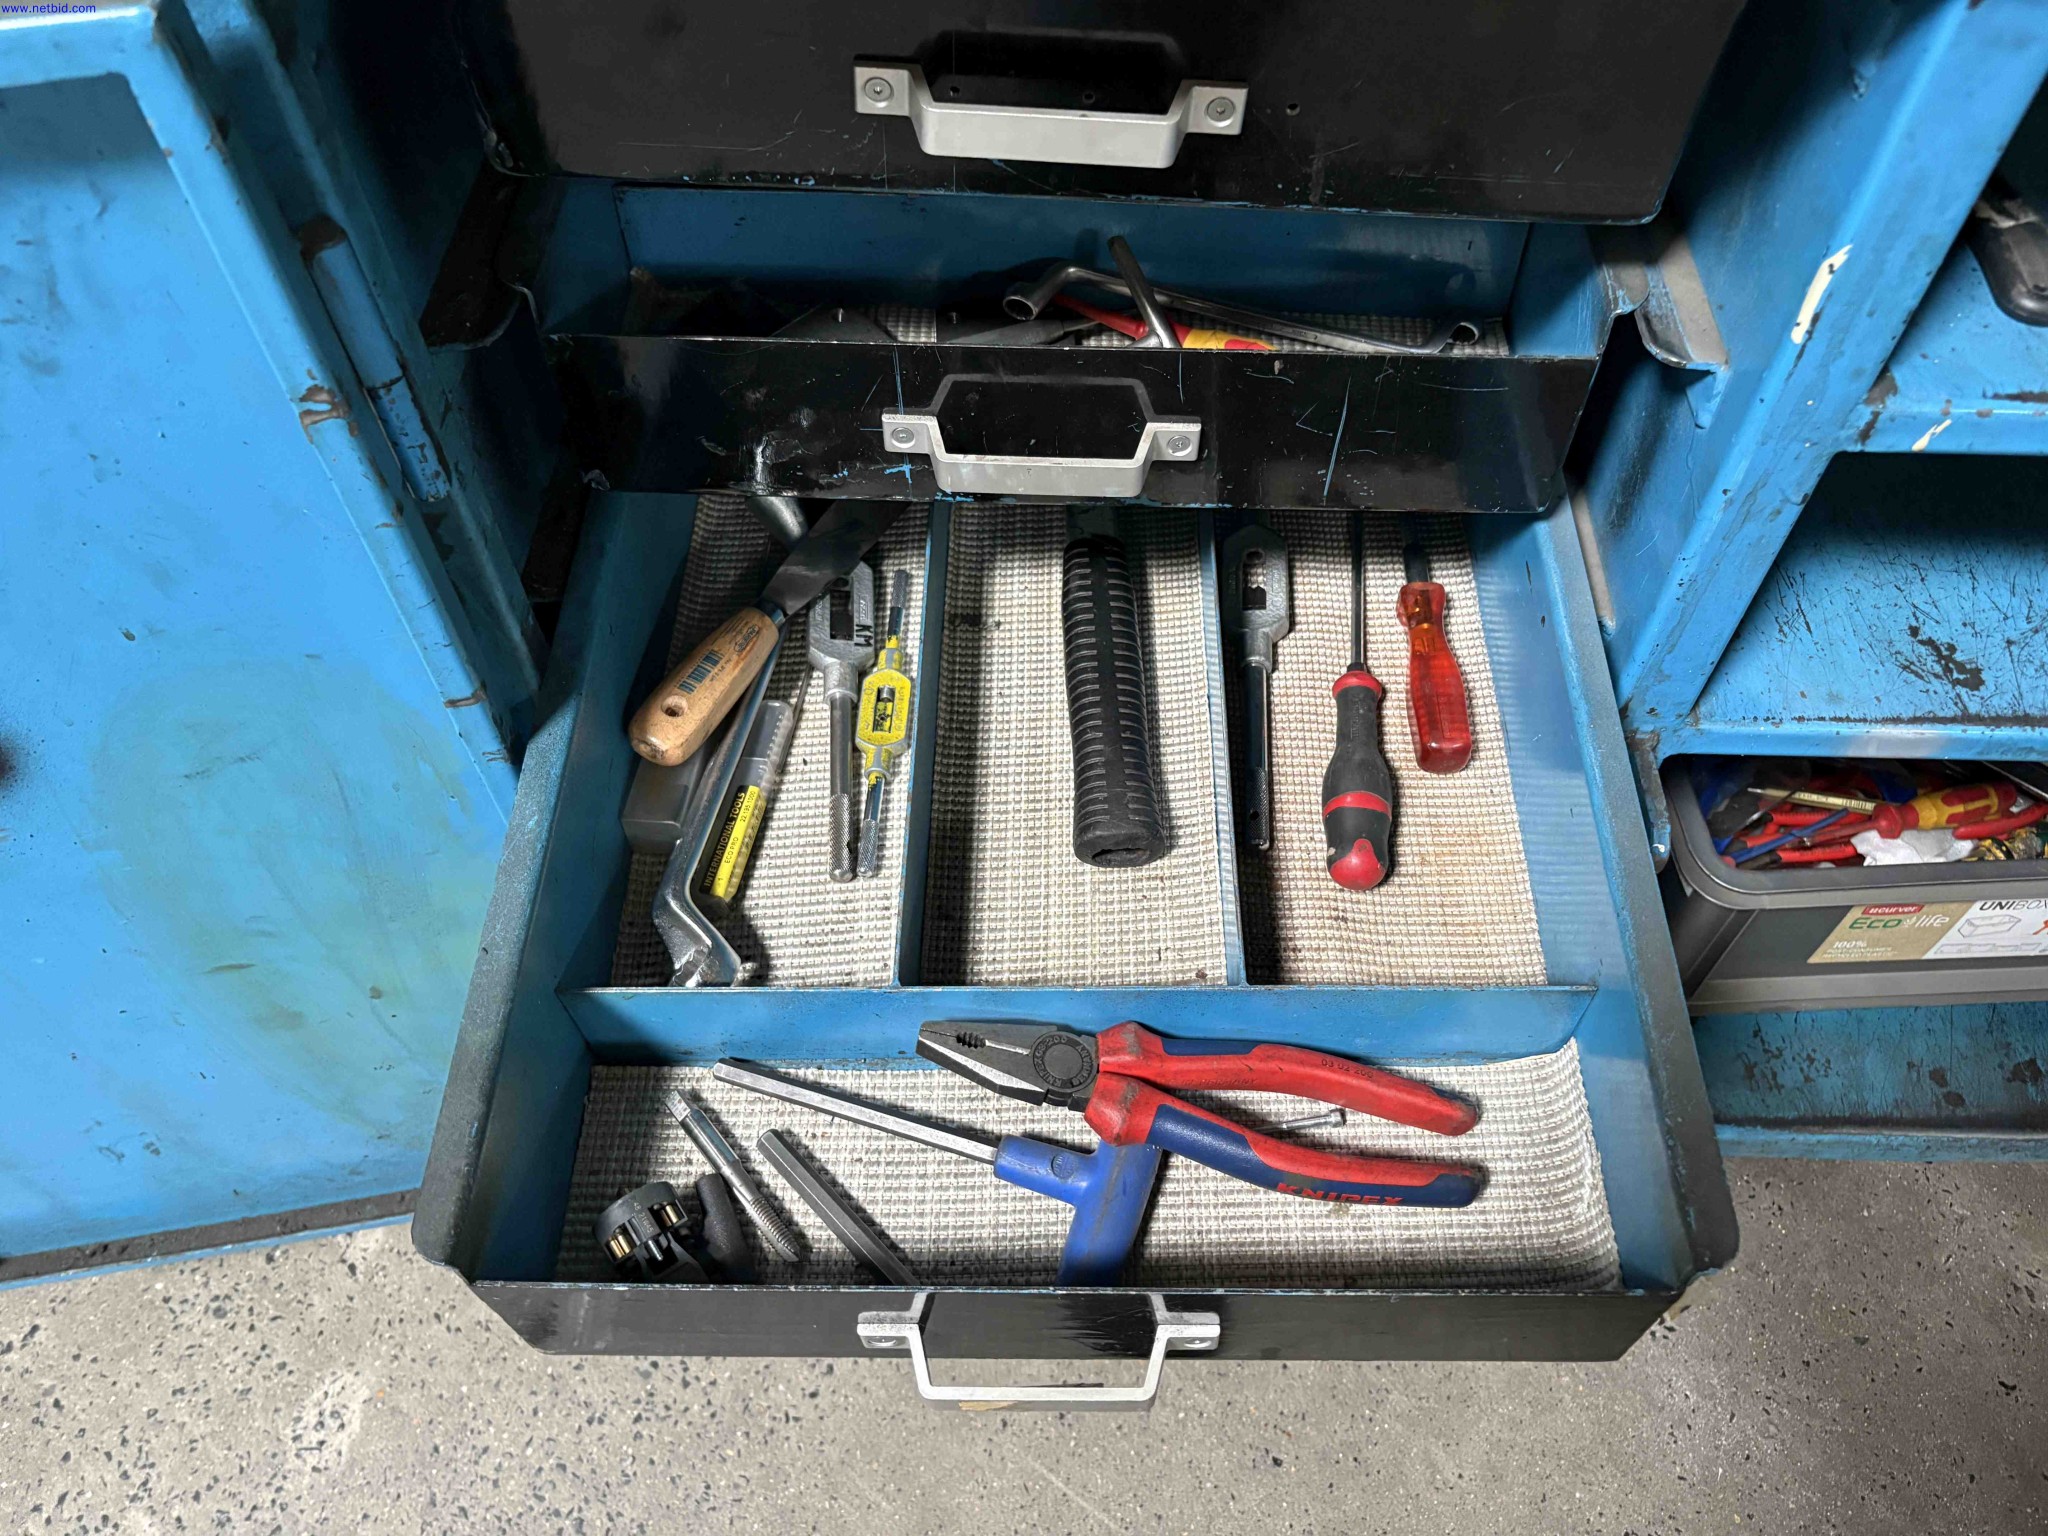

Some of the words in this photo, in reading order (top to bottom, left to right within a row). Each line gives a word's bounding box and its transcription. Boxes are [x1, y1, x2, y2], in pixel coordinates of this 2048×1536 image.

[704, 820, 736, 887] INTERNATIONAL
[730, 792, 746, 818] TOOLS
[1849, 916, 1903, 930] Eco
[1915, 914, 1949, 928] life
[1277, 1183, 1403, 1206] KNIPEX
